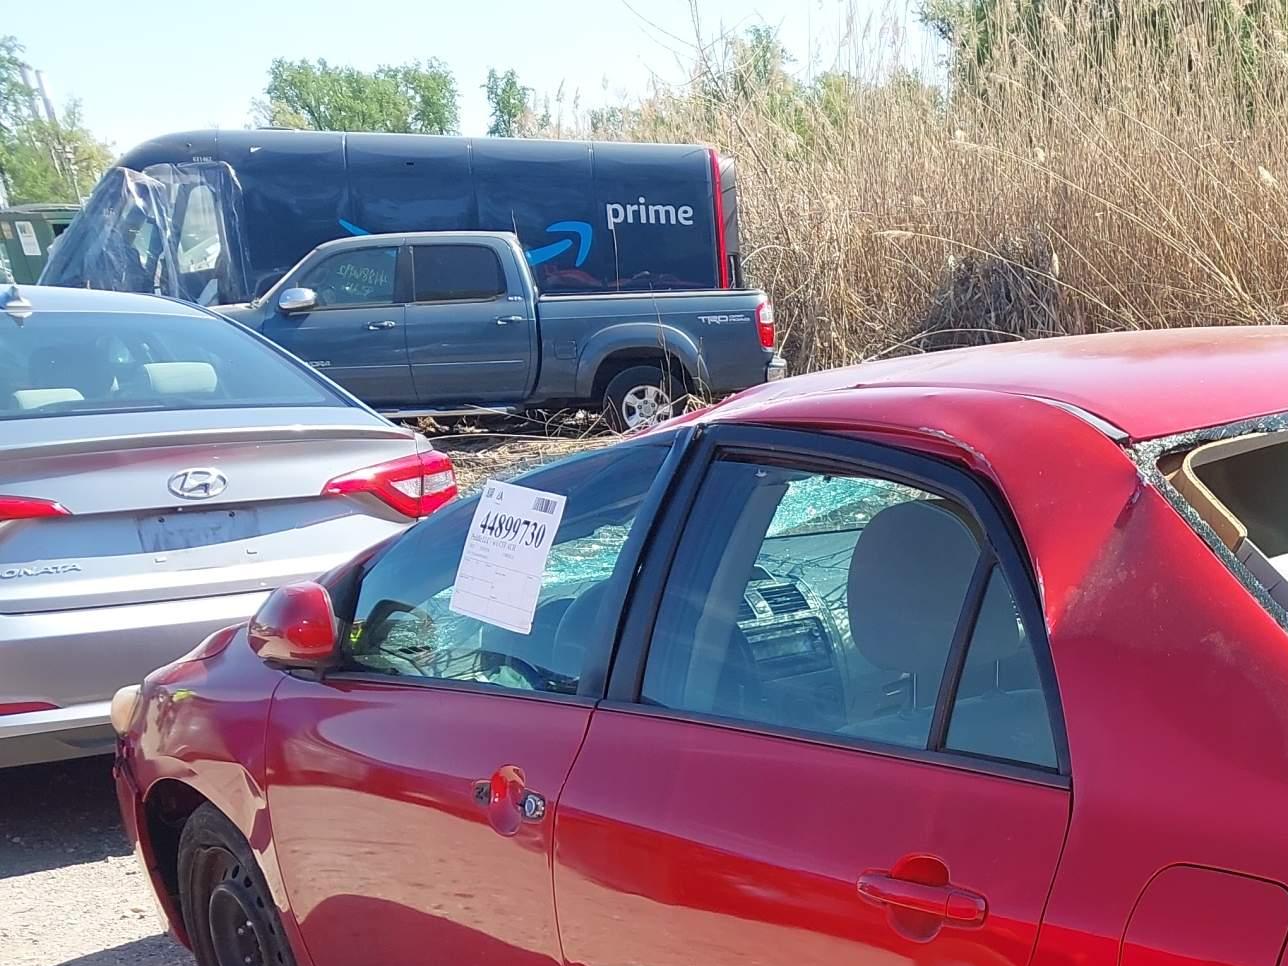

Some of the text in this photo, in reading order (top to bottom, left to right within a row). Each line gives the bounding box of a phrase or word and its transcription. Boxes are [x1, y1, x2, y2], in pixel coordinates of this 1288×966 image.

[606, 197, 694, 230] prime
[697, 315, 728, 325] TRD
[480, 511, 546, 548] 44899730
[0, 563, 82, 579] ONATA
